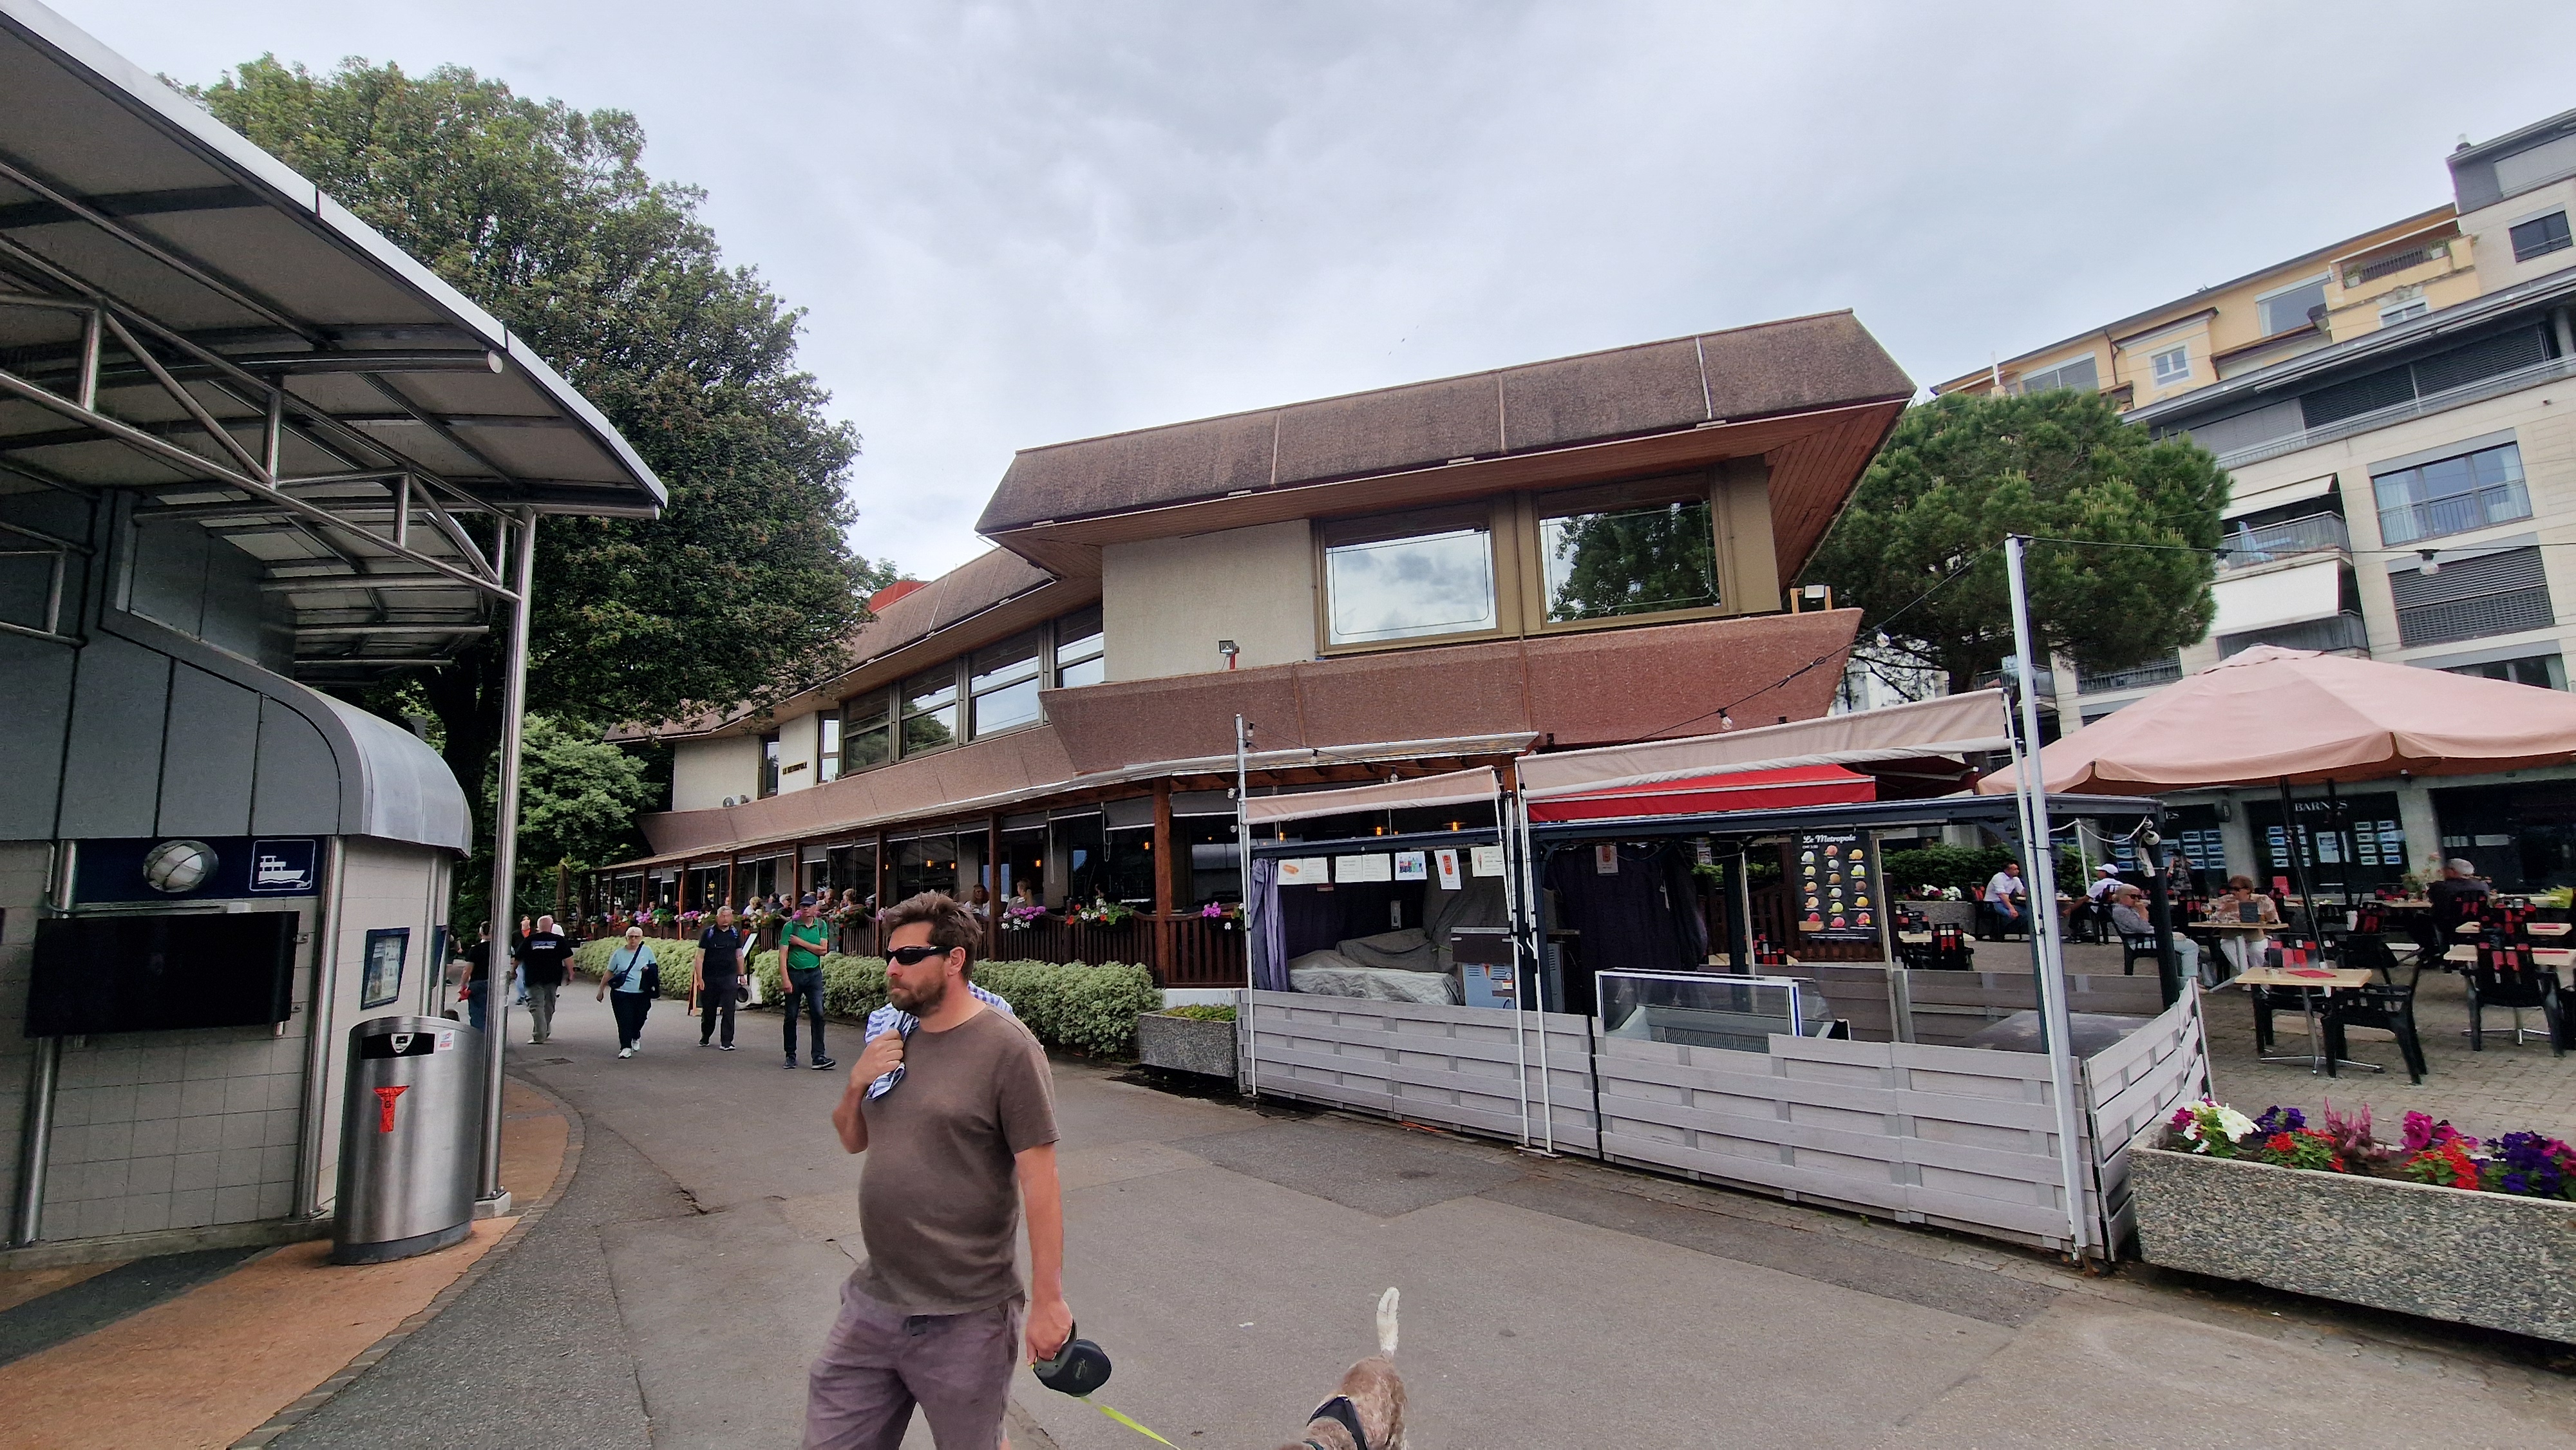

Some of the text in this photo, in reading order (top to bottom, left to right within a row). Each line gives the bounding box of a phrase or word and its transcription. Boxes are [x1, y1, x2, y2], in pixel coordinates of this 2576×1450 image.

[2294, 800, 2347, 811] BARNS
[1803, 834, 1856, 844] Le Metropole
